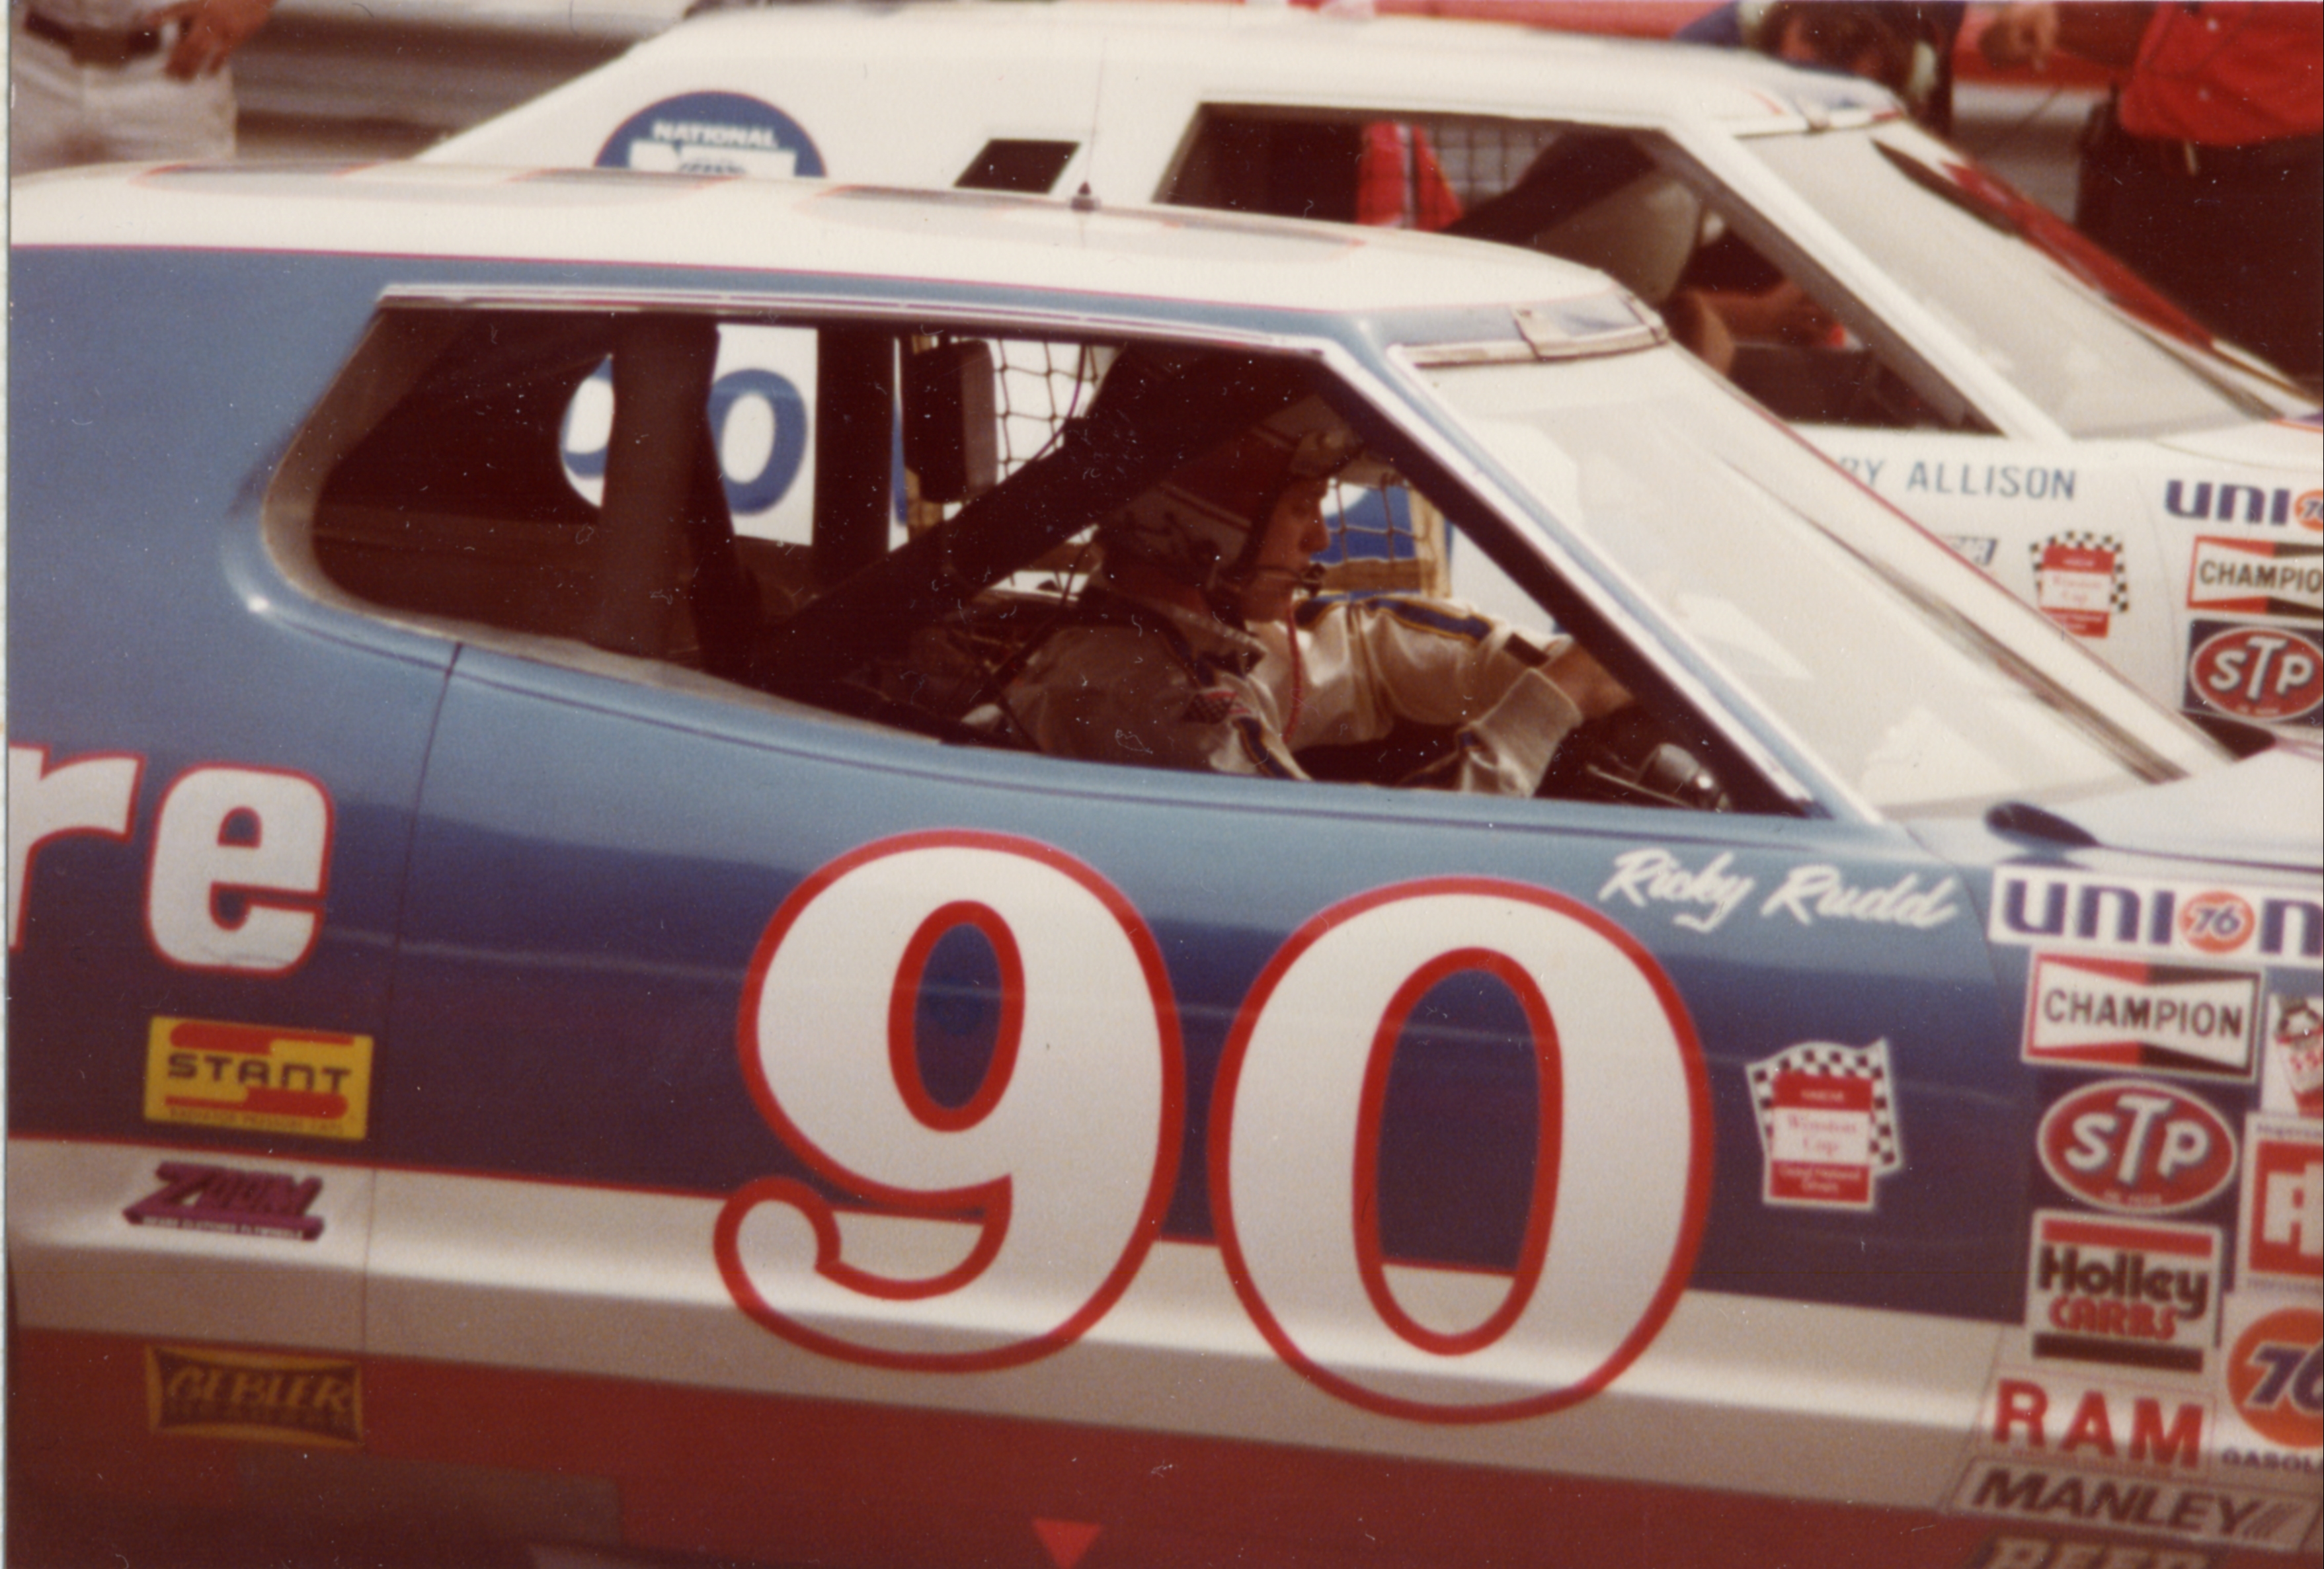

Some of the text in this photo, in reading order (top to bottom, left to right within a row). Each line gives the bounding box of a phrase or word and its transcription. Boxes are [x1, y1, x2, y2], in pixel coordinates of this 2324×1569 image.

[650, 120, 781, 149] NATIONAL
[1907, 461, 2077, 501] ALLISON
[2208, 635, 2314, 702] STP
[1598, 846, 1961, 934] Ricky Rudd
[2042, 989, 2244, 1039] CHAMPION
[167, 1052, 352, 1094] STANT
[713, 828, 1716, 1426] 90
[2064, 1094, 2210, 1186] STP
[2037, 1244, 2209, 1320] Holley
[2049, 1295, 2179, 1341] CARBS
[1993, 1377, 2204, 1470] RAM
[1972, 1466, 2259, 1537] MANLEY
